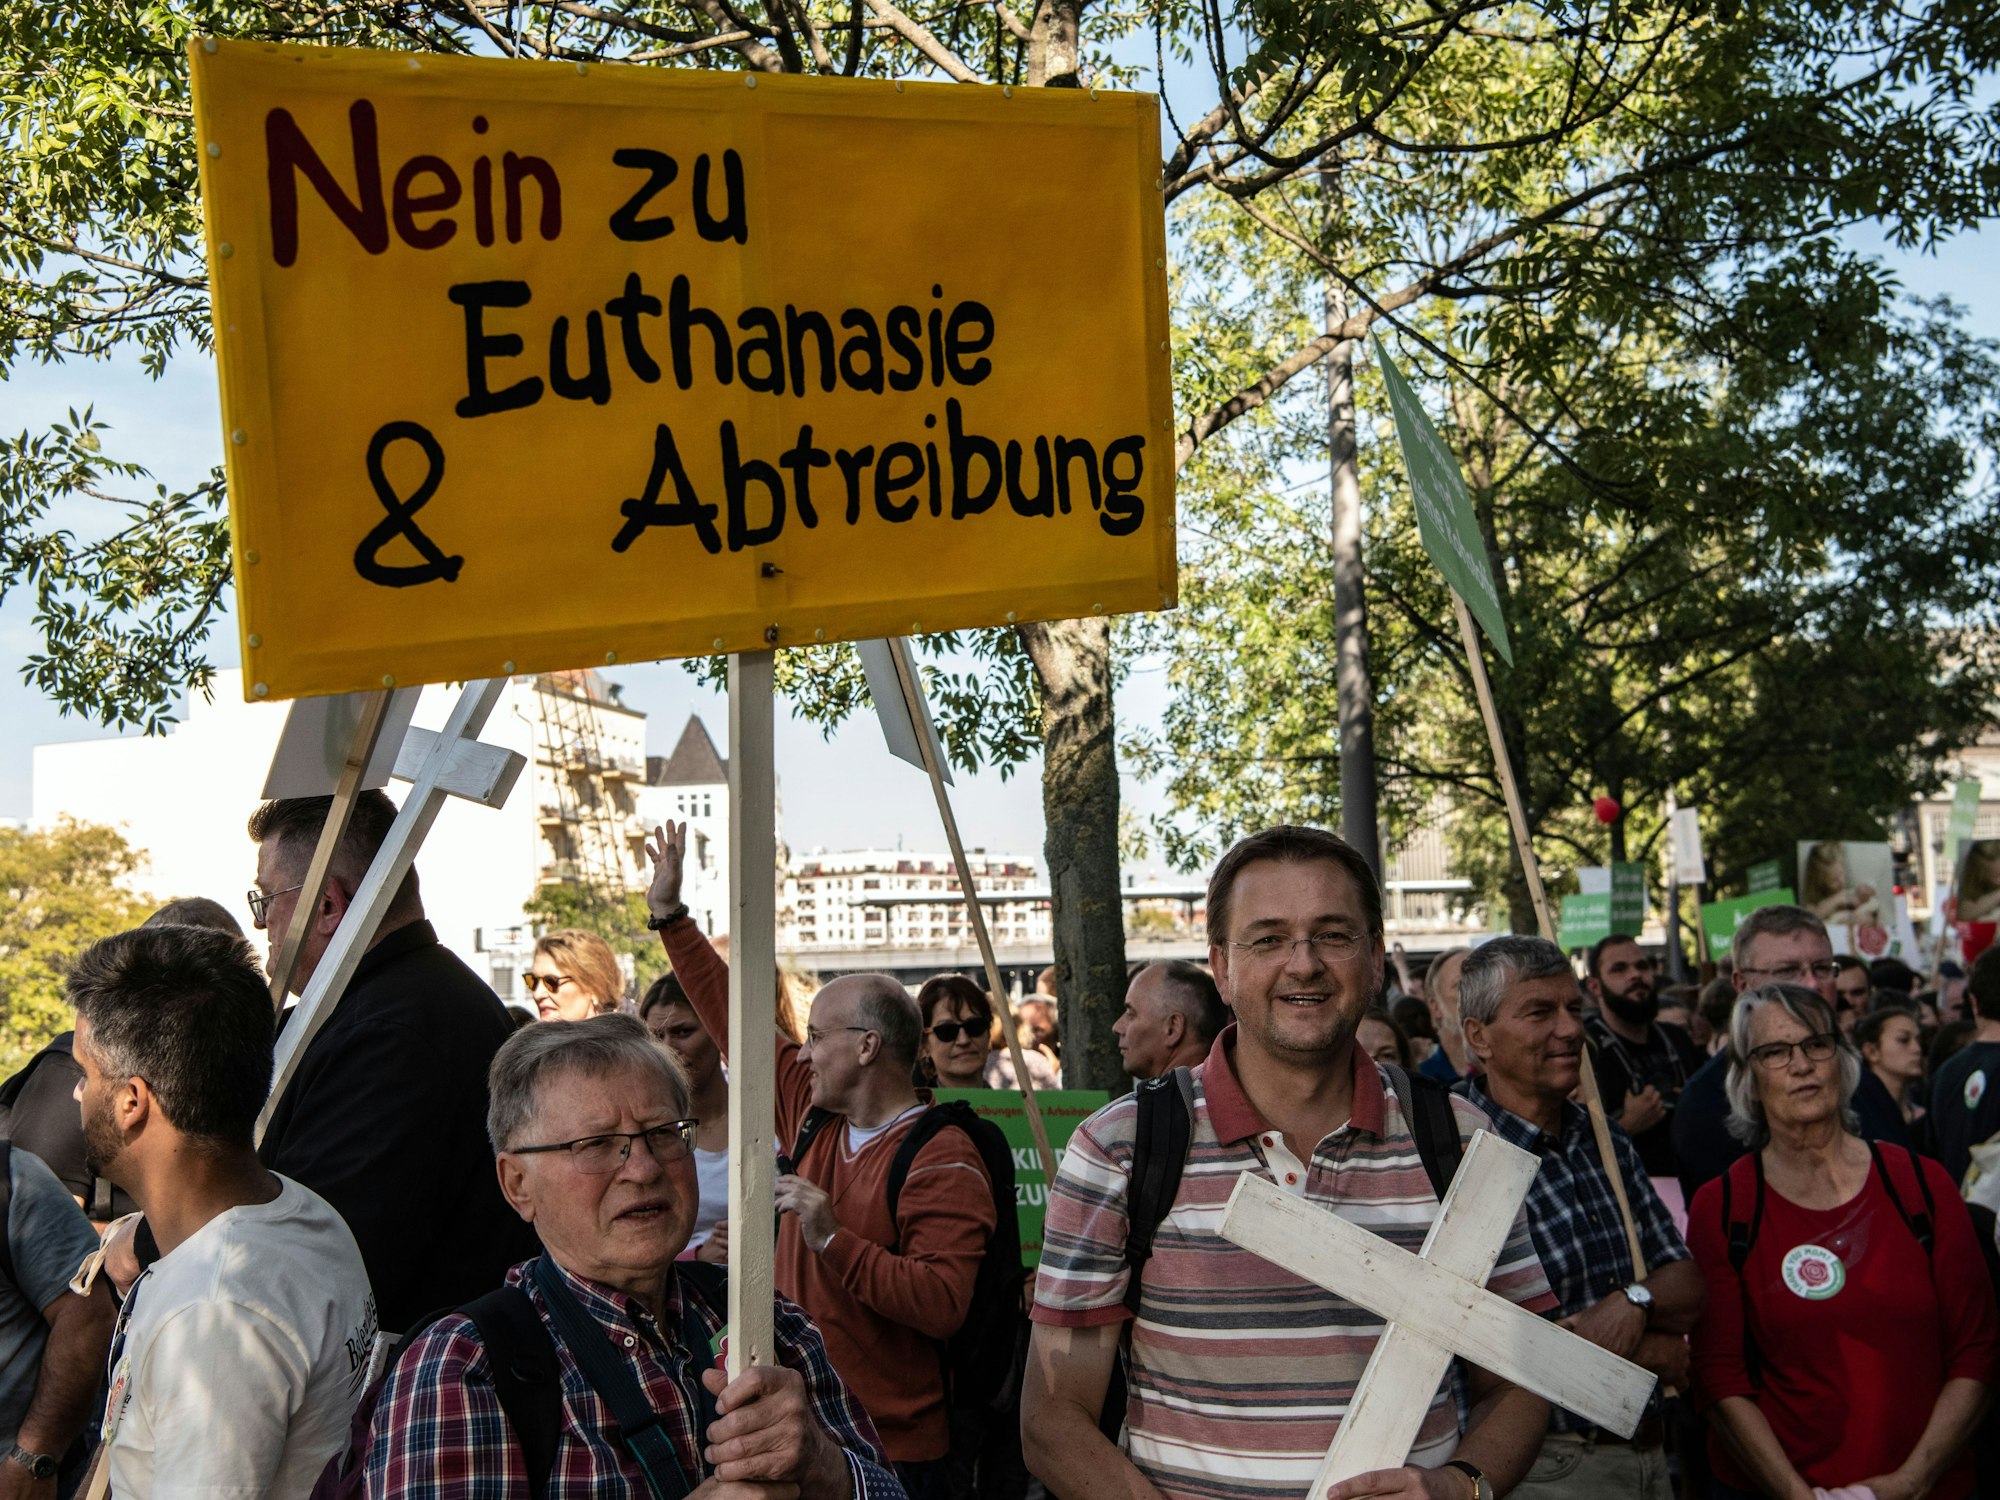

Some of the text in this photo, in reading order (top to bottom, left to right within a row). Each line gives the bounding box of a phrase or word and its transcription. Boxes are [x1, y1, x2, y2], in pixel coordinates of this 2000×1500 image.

[266, 98, 750, 268] Nein zu
[447, 271, 995, 419] Euthanasie
[352, 397, 1147, 588] & Abtreibung
